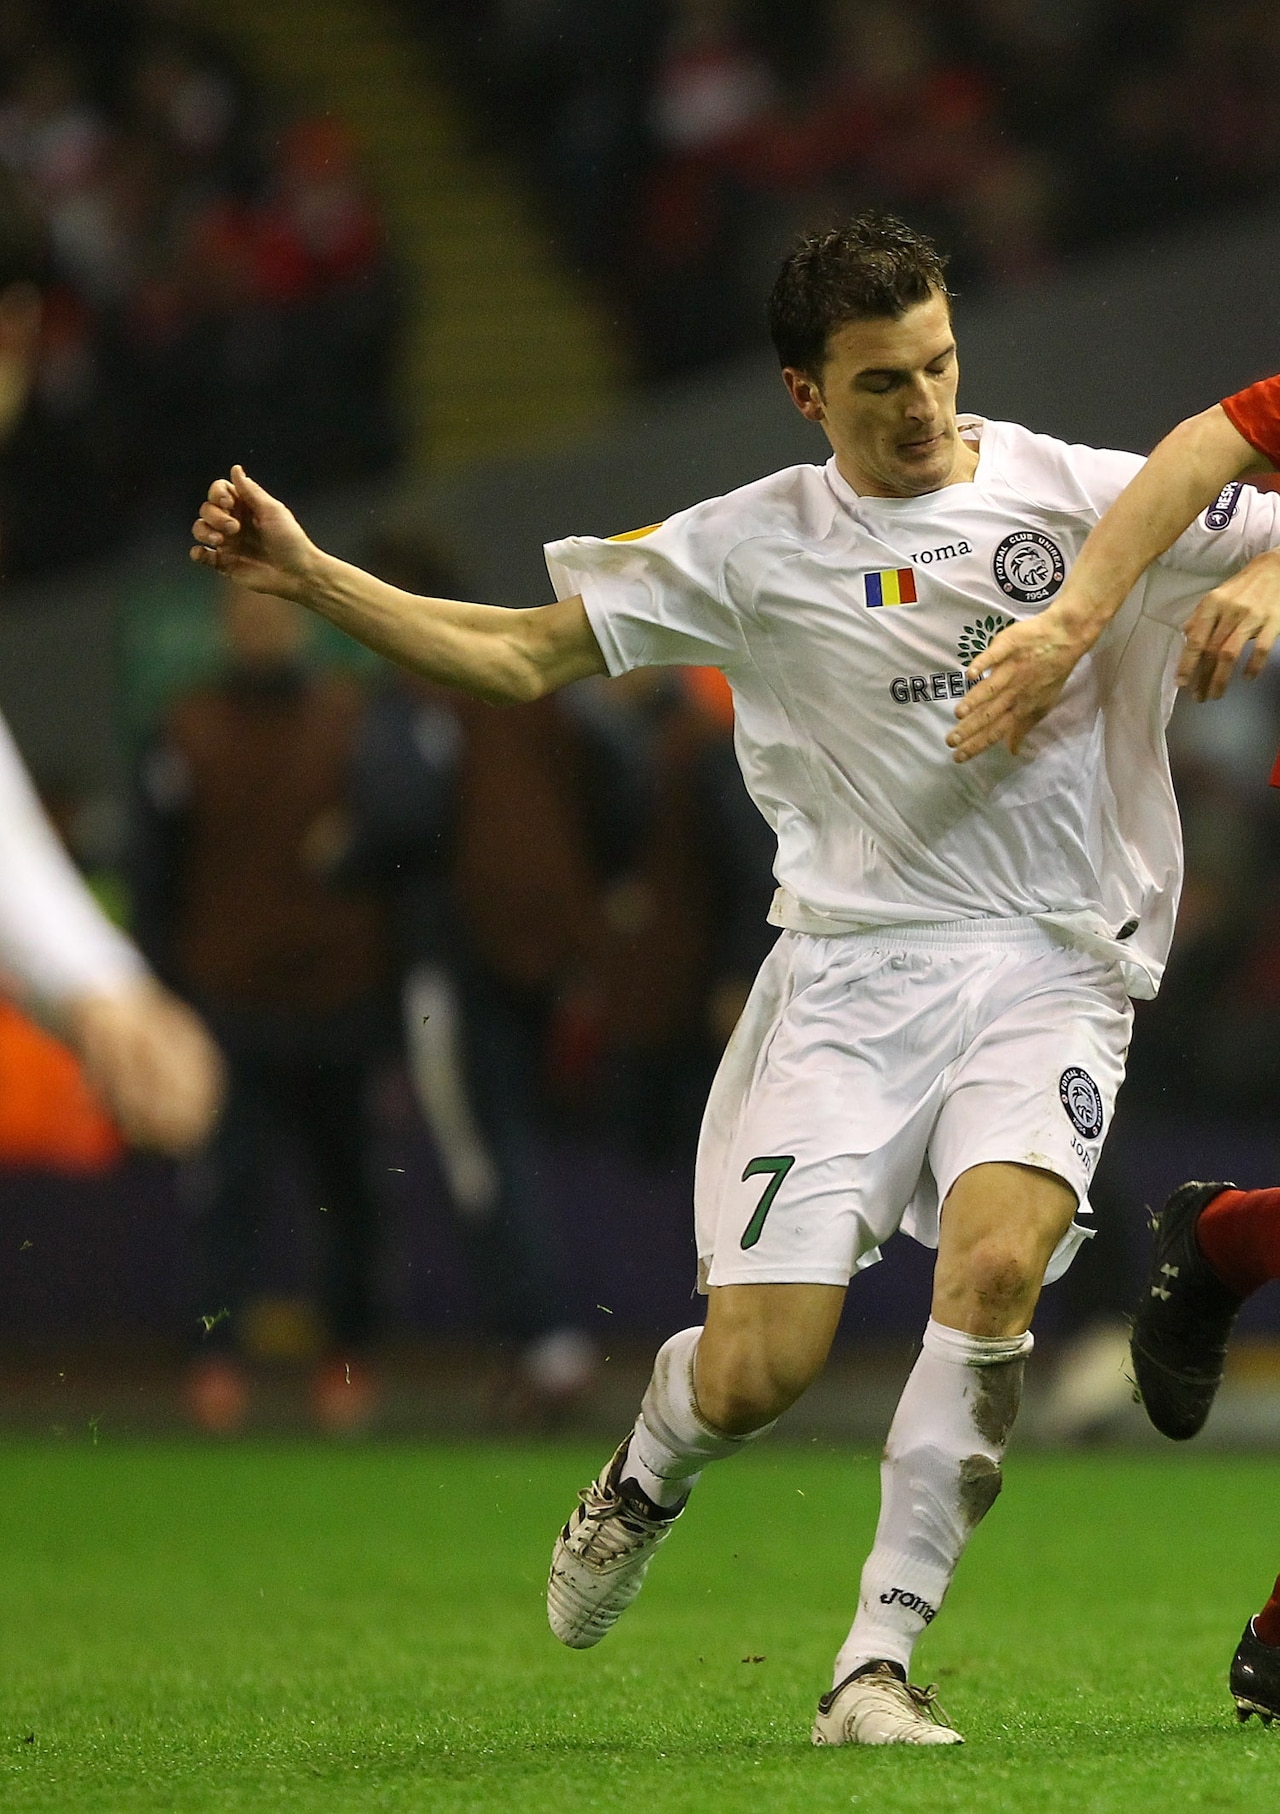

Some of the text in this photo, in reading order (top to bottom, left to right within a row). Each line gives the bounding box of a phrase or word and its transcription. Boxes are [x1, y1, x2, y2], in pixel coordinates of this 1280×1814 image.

[996, 533, 1062, 581] FOTBAL CLUB UNIREA
[1025, 588, 1050, 600] 1954
[740, 1155, 796, 1250] 7
